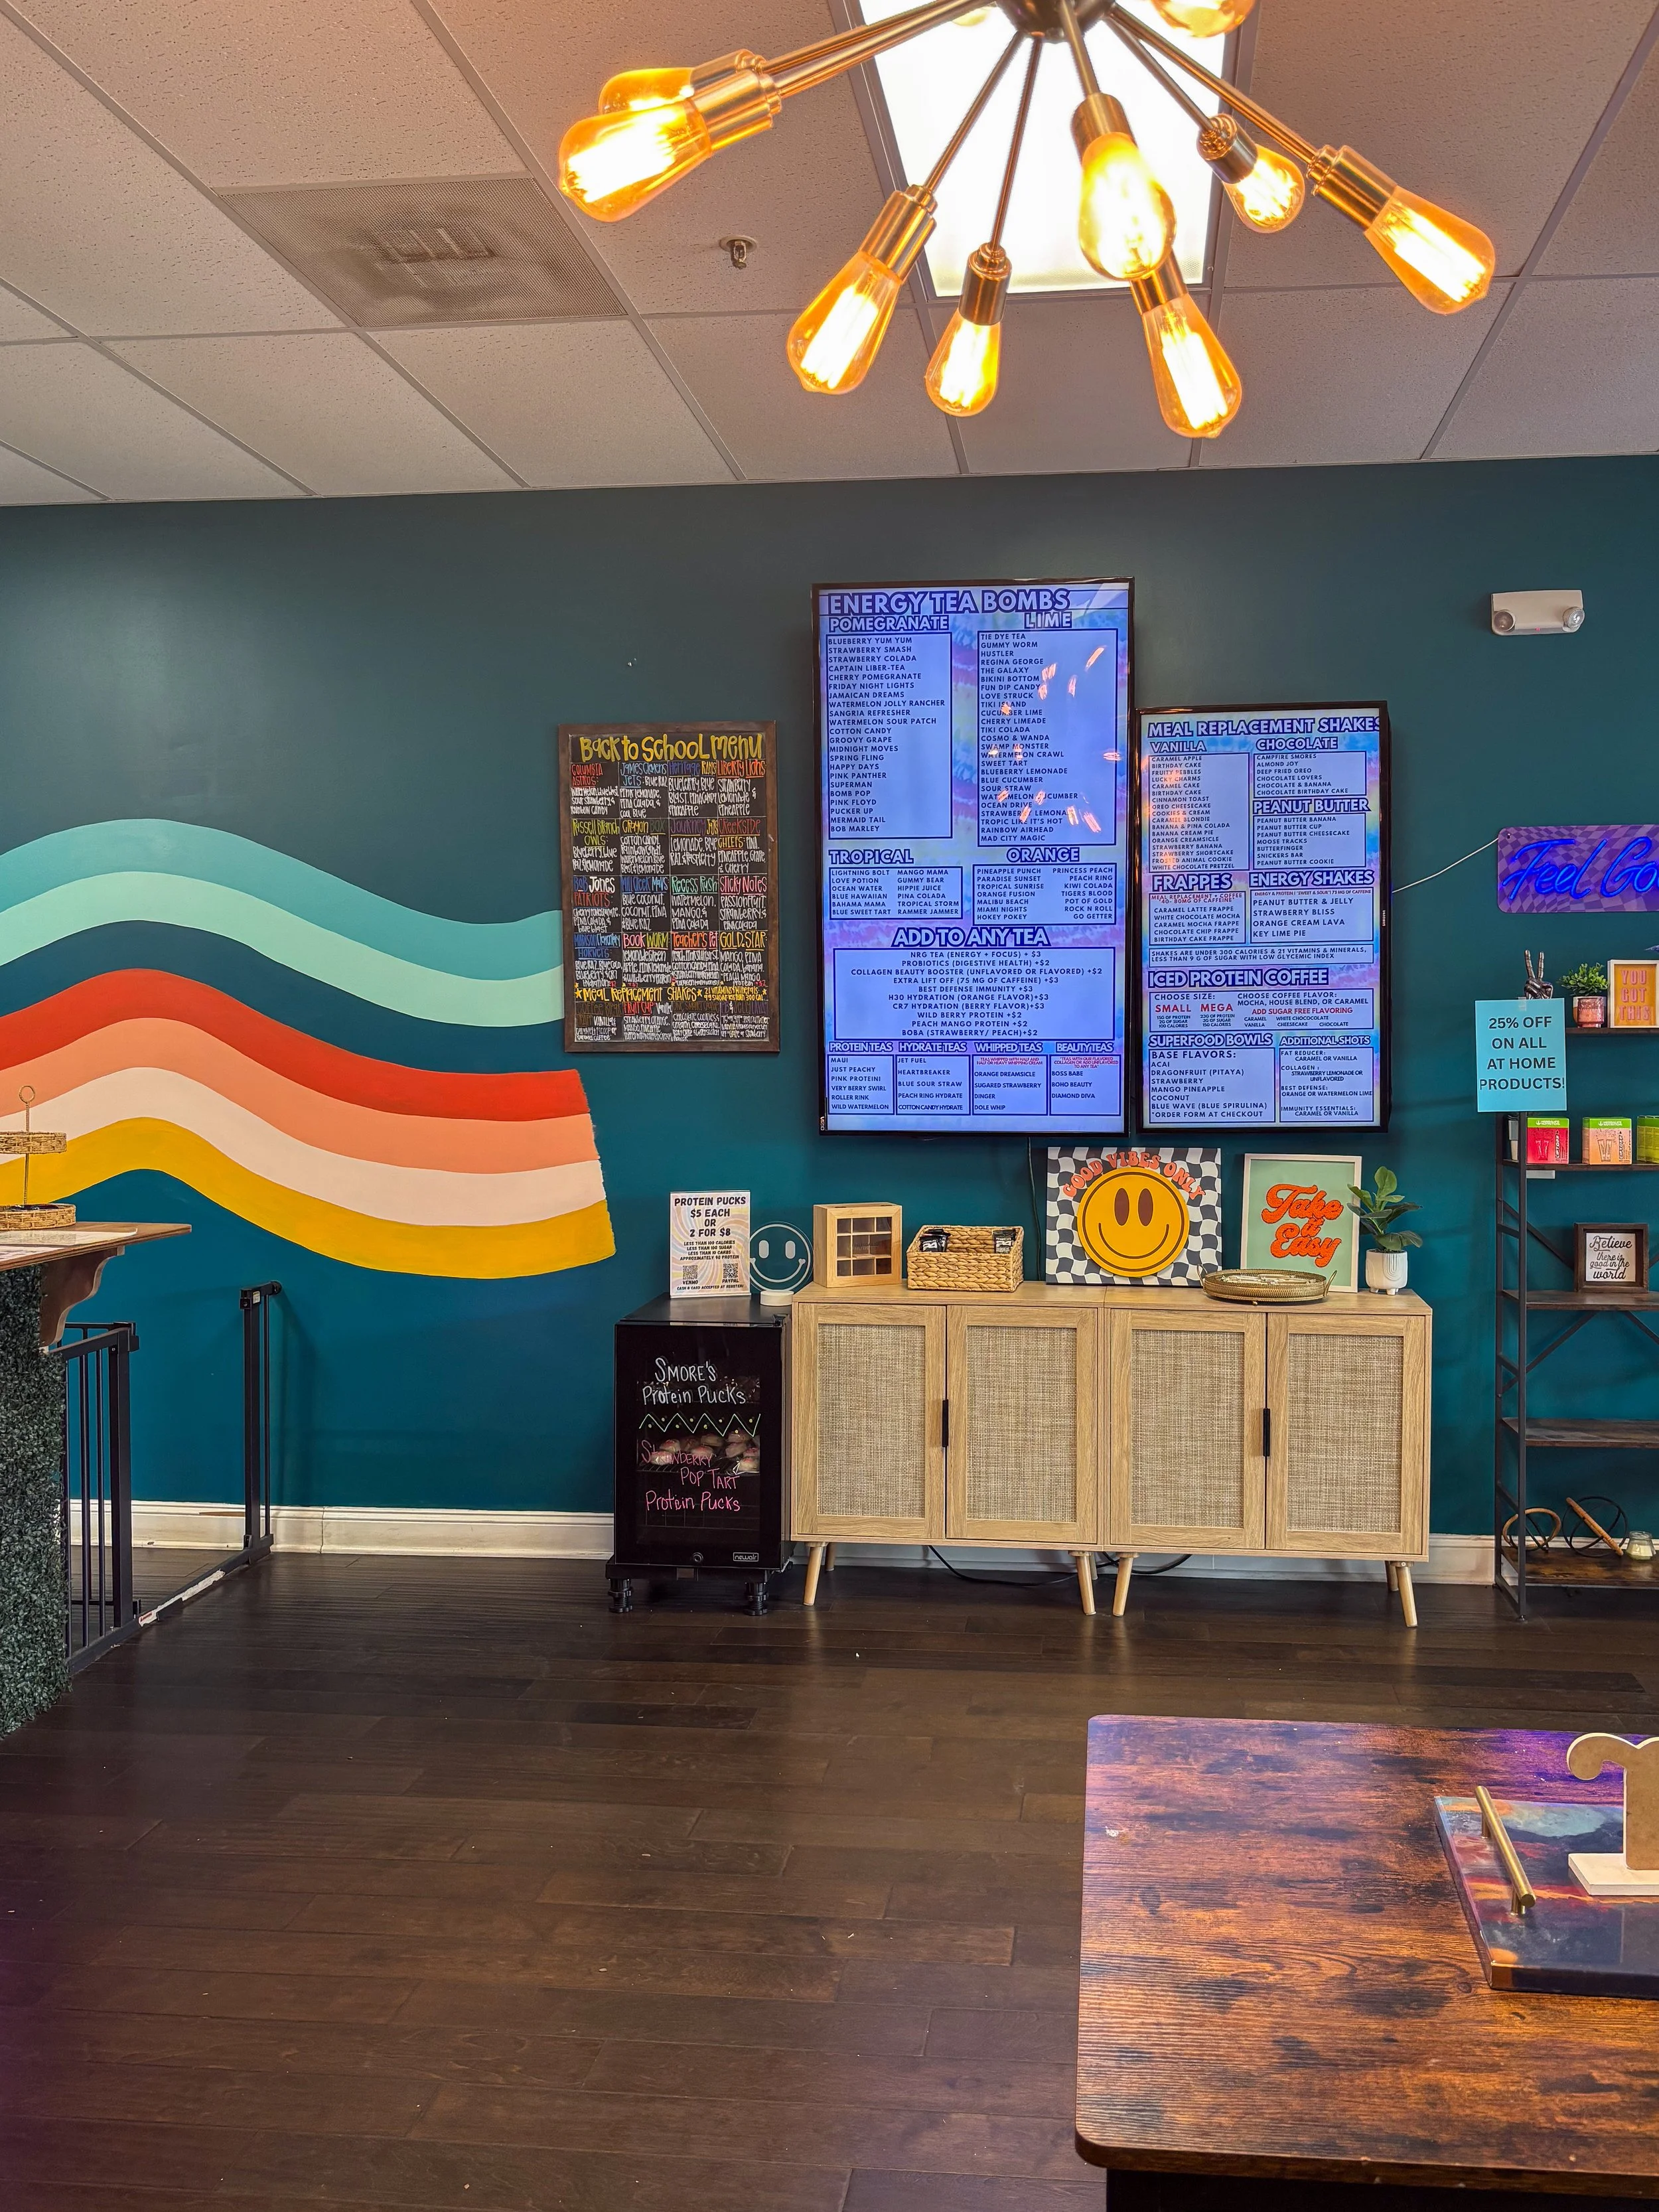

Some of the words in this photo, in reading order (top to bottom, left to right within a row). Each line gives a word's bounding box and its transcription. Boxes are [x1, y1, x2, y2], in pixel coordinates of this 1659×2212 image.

[828, 592, 928, 615] ENERGY
[930, 591, 978, 614] TEA
[981, 589, 1070, 613] BOMBS
[830, 615, 949, 632] POMEGRANATE
[1024, 611, 1072, 629] LIME
[1147, 722, 1193, 738] MEAL
[1196, 719, 1316, 736] REPLACEMENT
[621, 735, 638, 761] to
[1150, 741, 1206, 753] VANILLA
[1256, 737, 1338, 751] CHOCOLATE
[1253, 798, 1312, 814] PEANUT
[1313, 798, 1371, 813] BUTTER
[829, 849, 914, 864] TROPICAL
[1007, 848, 1080, 862] ORANGE
[1502, 838, 1607, 901] Feel
[1601, 836, 1659, 898] Go
[1153, 873, 1232, 891] FRAPPES
[1249, 872, 1313, 887] ENERGY
[1312, 870, 1374, 886] SHAKES
[891, 927, 936, 947] ADD
[936, 927, 965, 946] TO
[964, 926, 1011, 946] ANY
[1010, 926, 1051, 946] TEA
[1148, 970, 1188, 988] ICED
[1189, 969, 1263, 988] PROTEIN
[1263, 968, 1329, 986] COFFEE
[1621, 970, 1646, 985] YOU
[1621, 988, 1646, 1002] GOT
[1155, 1004, 1191, 1013] SMALL
[1619, 1005, 1650, 1021] THIS
[1489, 1017, 1518, 1029] 25%
[1523, 1016, 1551, 1028] OFF
[829, 1042, 869, 1052] PROTEIN
[869, 1042, 893, 1052] TEAS
[899, 1042, 943, 1052] HYDRATE
[942, 1042, 967, 1052] TEAS
[1148, 1034, 1226, 1047] SUPERFOOD
[1225, 1033, 1273, 1047] BOWLS
[1279, 1035, 1338, 1046] ADDITIONAL
[1337, 1035, 1370, 1045] SHOTS
[1492, 1037, 1514, 1049] ON
[1519, 1037, 1547, 1049] ALL
[974, 1042, 1019, 1053] WHIPPED
[1019, 1042, 1043, 1053] TEAS
[1056, 1042, 1092, 1053] BEAUTY
[1091, 1043, 1114, 1053] TEAS
[1183, 1050, 1236, 1059] FLAVORS:
[1487, 1059, 1505, 1070] AT
[1510, 1057, 1555, 1069] HOME
[1480, 1078, 1564, 1090] PRODUCTS!
[1062, 1160, 1104, 1198] GOOD
[1106, 1151, 1161, 1170] VIBES
[1163, 1161, 1206, 1200] ONLY
[674, 1196, 713, 1207] PROTEIN
[717, 1196, 746, 1205] PUCKS
[1262, 1184, 1344, 1224] Take
[690, 1209, 701, 1218] $5
[705, 1209, 730, 1217] EACH
[699, 1228, 715, 1237] FOR
[719, 1228, 731, 1237] $8
[1270, 1222, 1342, 1268] Easy
[1589, 1236, 1632, 1252] Believe
[1597, 1252, 1616, 1261] there
[1617, 1258, 1630, 1269] the
[1593, 1268, 1626, 1279] world
[642, 1386, 691, 1406] Protein
[680, 1467, 701, 1487] POP
[705, 1468, 741, 1489] TART
[646, 1490, 695, 1511] Protein
